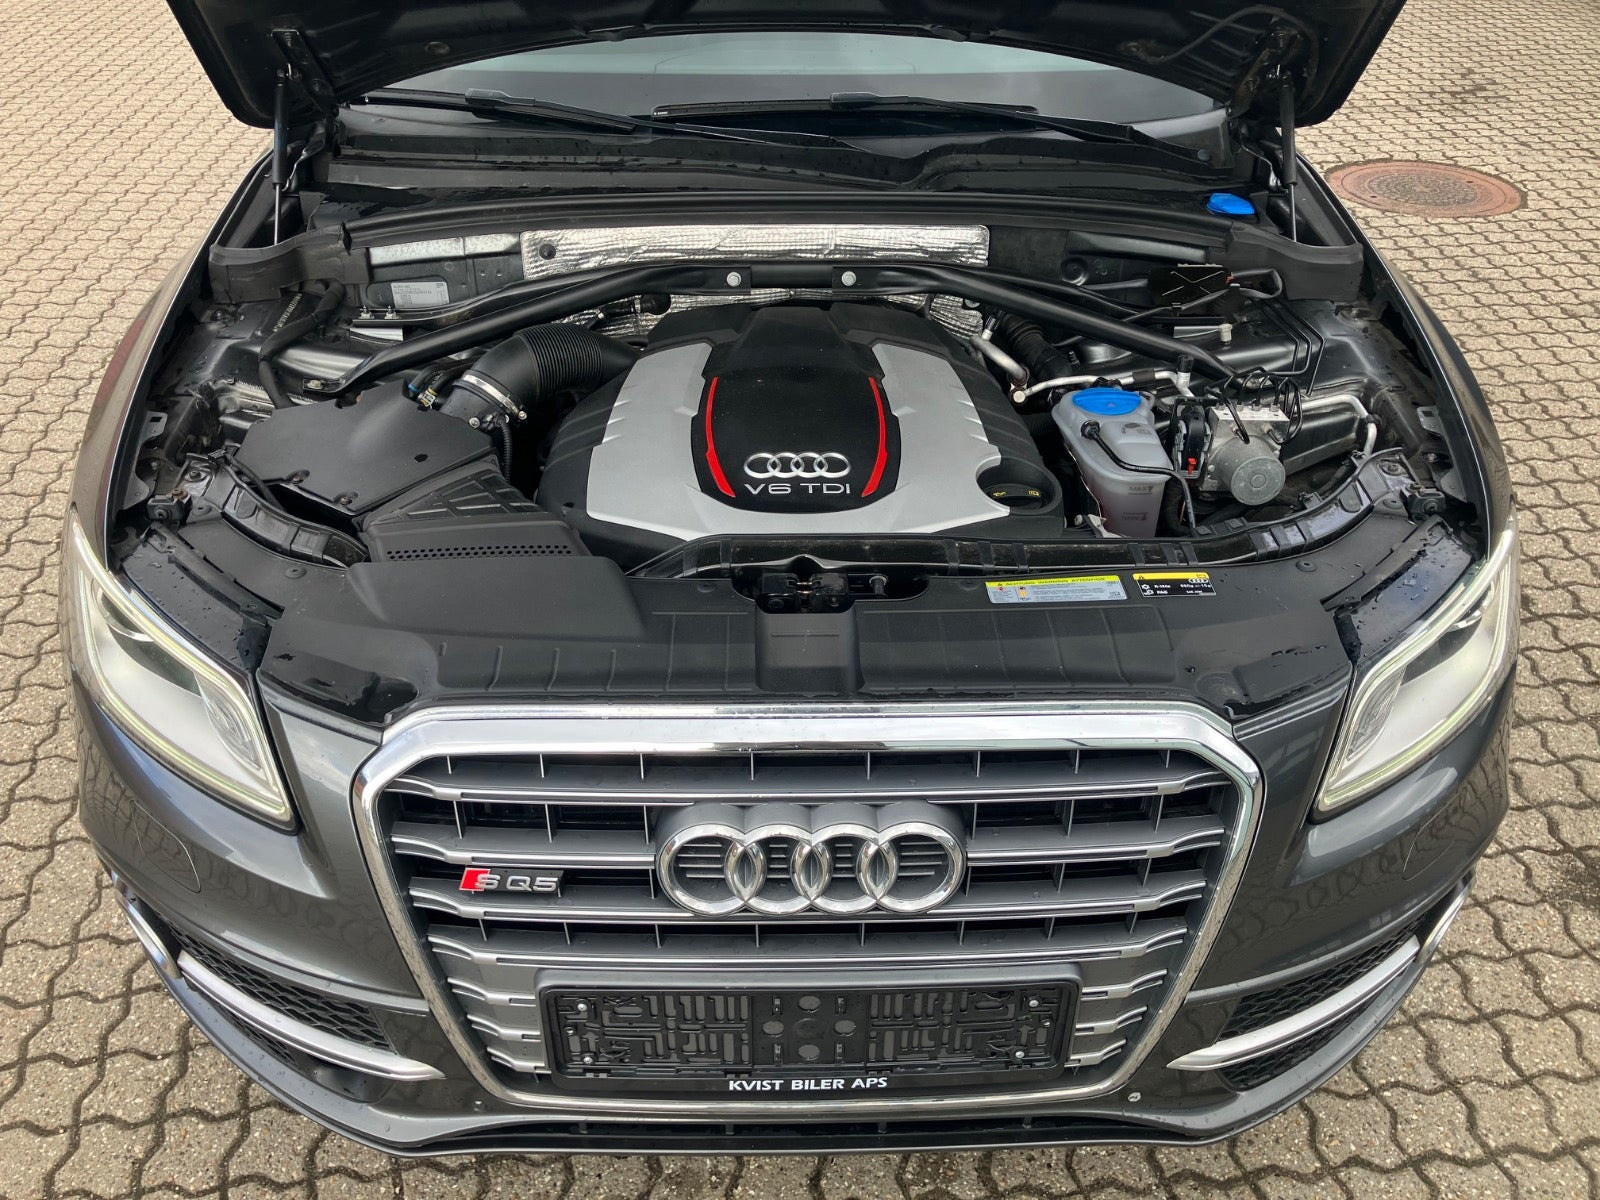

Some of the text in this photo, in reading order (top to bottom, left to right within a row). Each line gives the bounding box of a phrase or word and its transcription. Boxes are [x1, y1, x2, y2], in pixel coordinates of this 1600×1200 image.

[744, 483, 851, 495] V6 TDI
[728, 1077, 888, 1091] KVIST BILER APS
